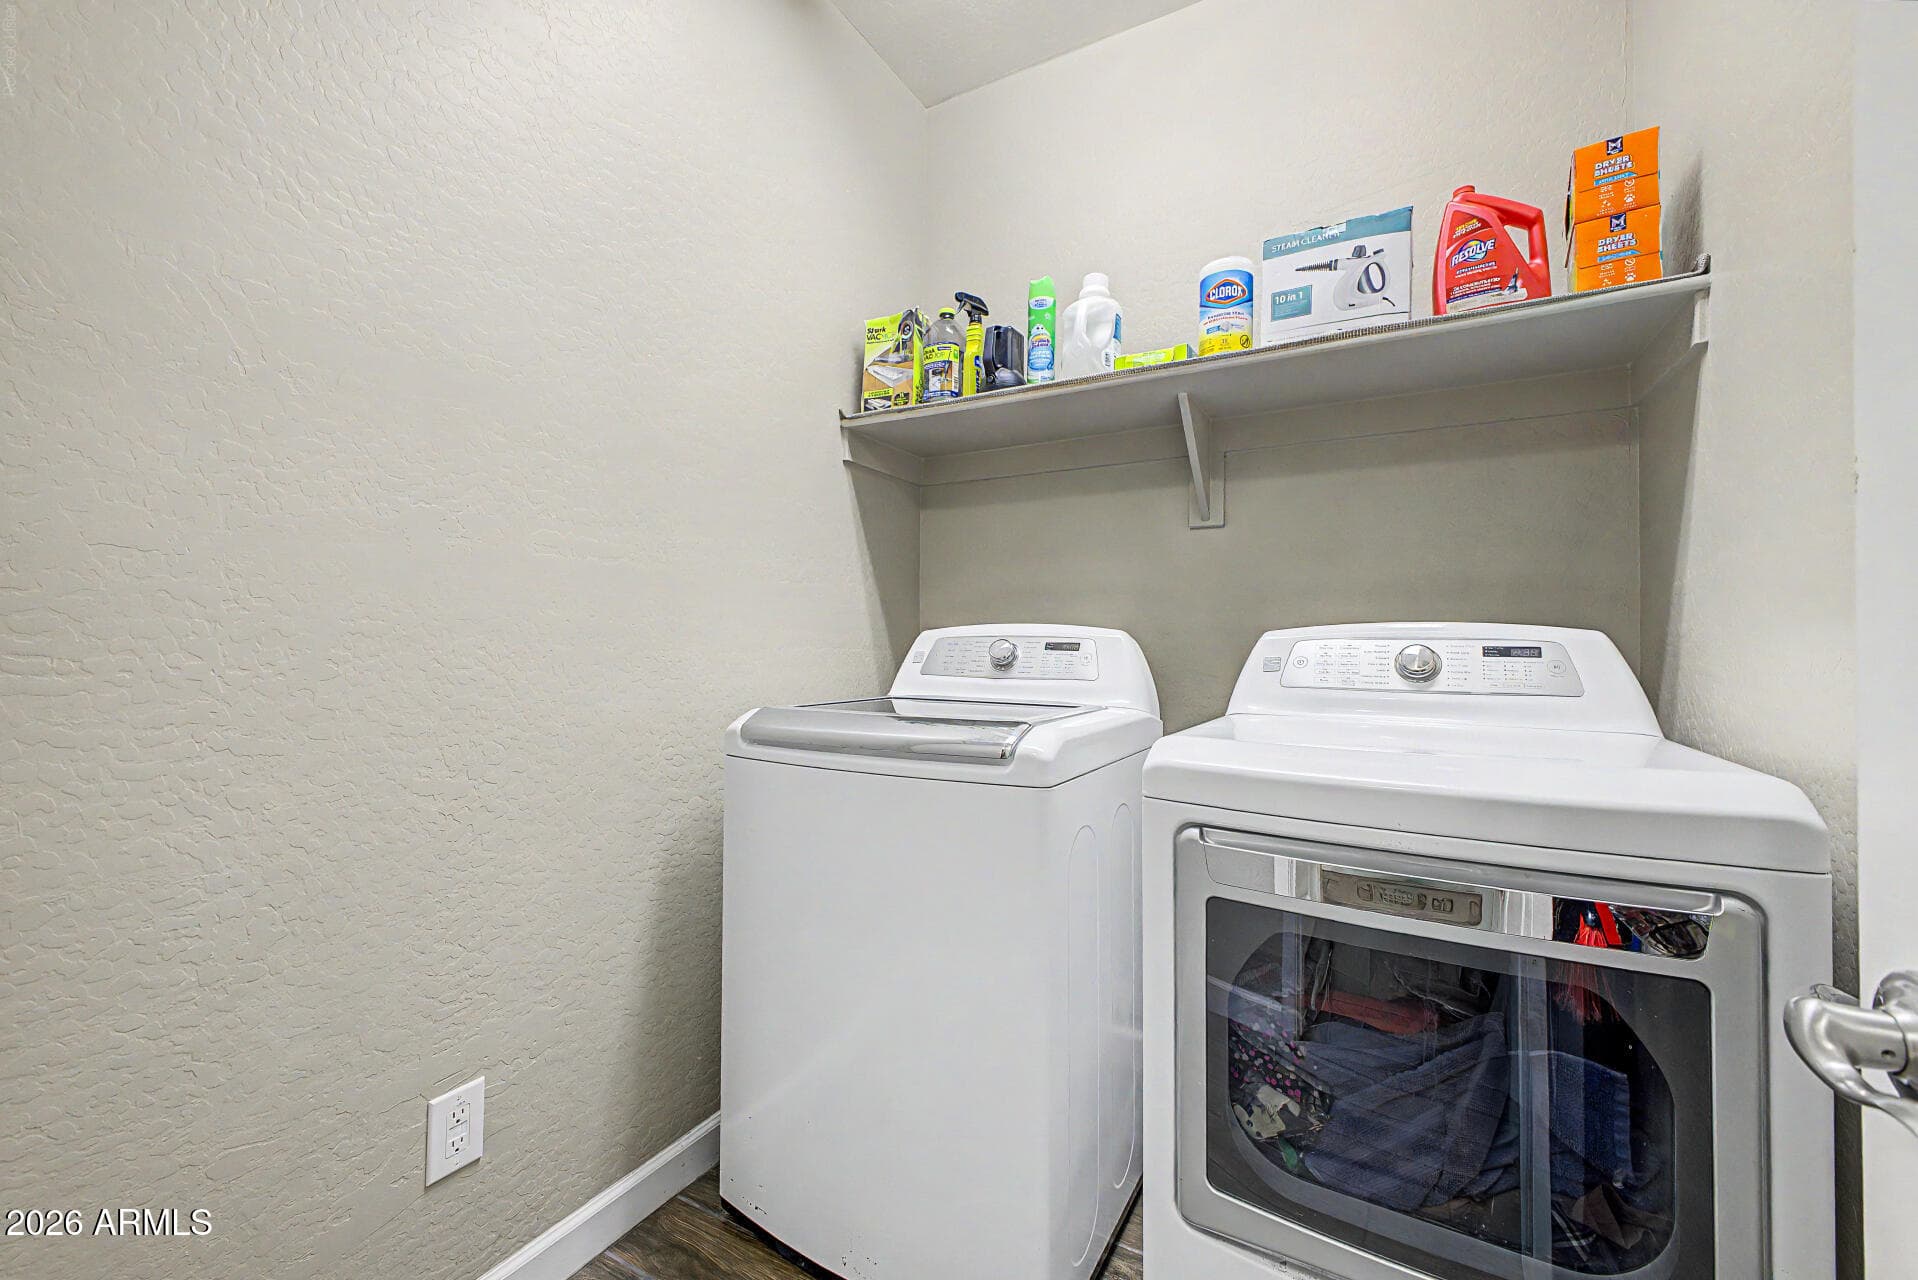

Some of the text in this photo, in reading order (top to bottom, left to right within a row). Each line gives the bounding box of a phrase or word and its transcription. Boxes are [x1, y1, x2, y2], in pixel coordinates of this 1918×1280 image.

[1594, 161, 1633, 177] SHEETS
[1595, 155, 1630, 170] DRYER
[1272, 240, 1300, 253] STEAM
[1598, 233, 1633, 246] DRYER
[1598, 239, 1637, 253] SHEETS
[1451, 239, 1497, 268] RESOLVE
[1209, 286, 1243, 300] CLOROX
[1274, 291, 1303, 305] 10 in 1
